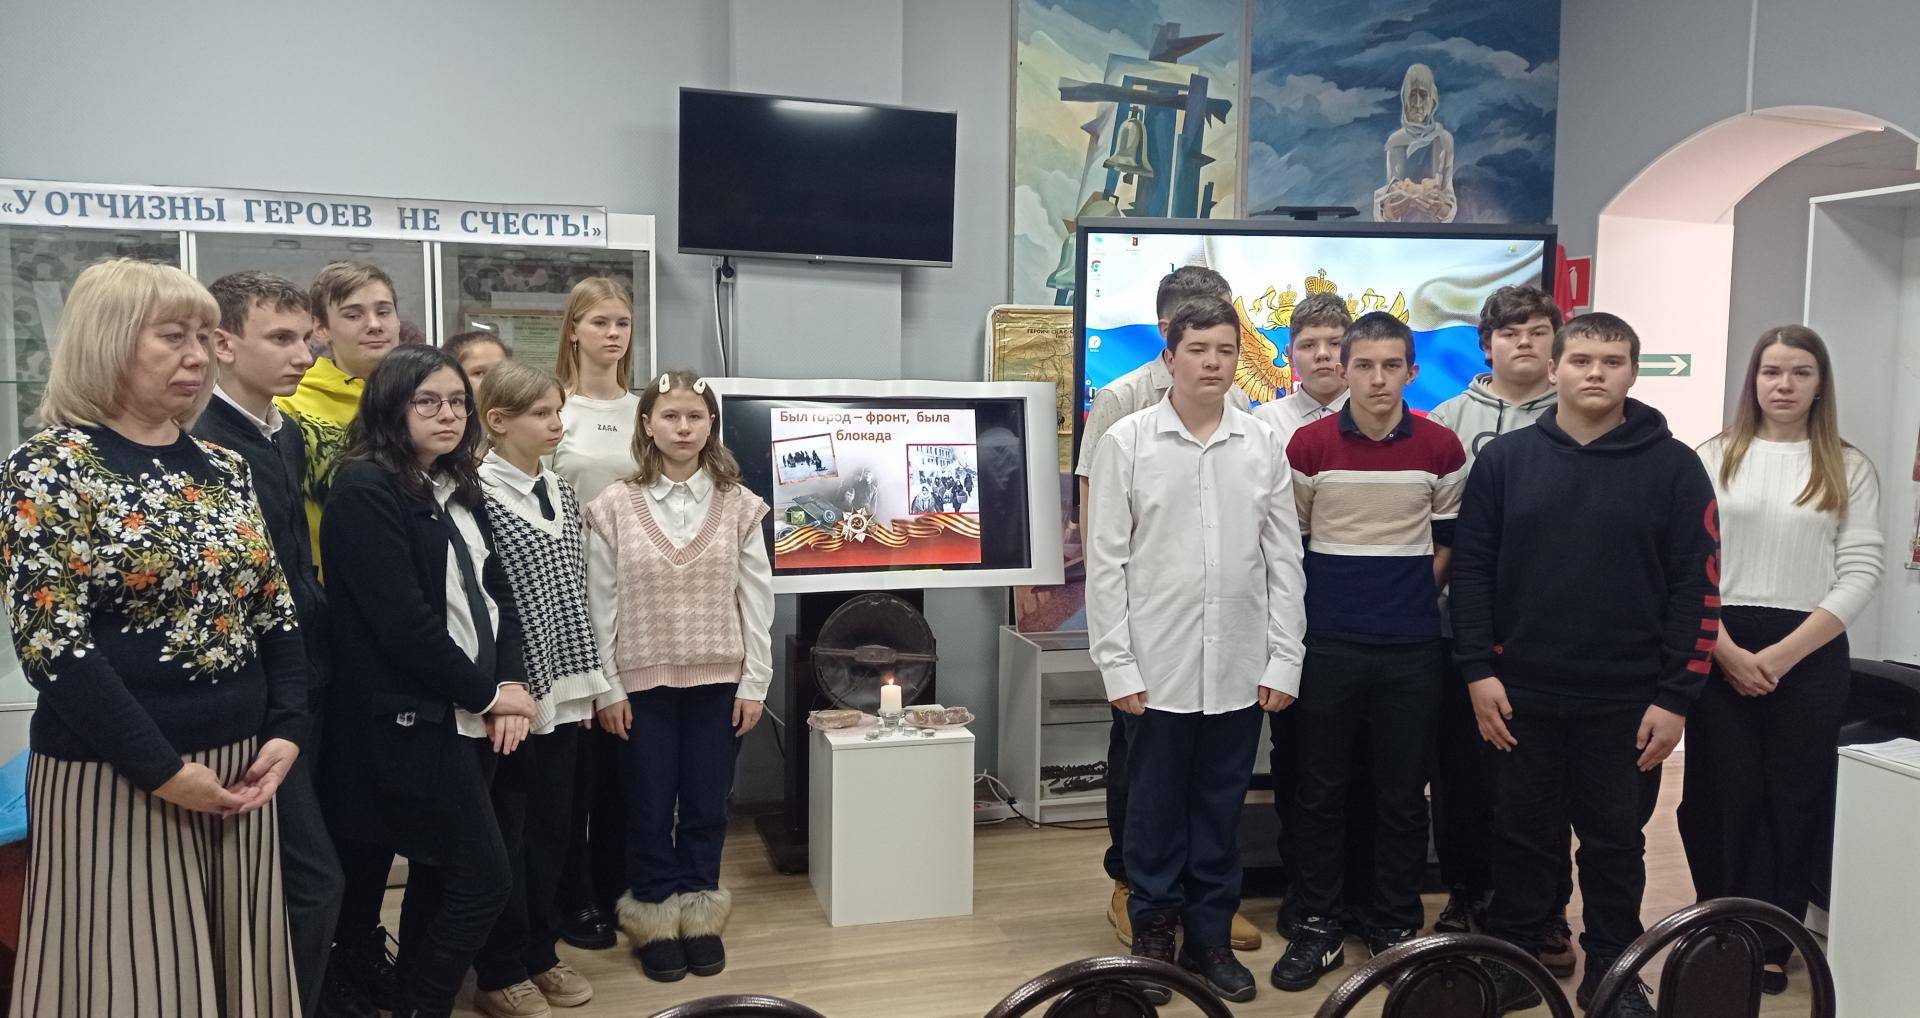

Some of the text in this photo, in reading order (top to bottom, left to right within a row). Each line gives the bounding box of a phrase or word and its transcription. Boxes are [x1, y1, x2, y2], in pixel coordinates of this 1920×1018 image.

[1, 189, 602, 237] «У ОТЧИЗНЫ ГЕРОЕВ НЕ СЧЕСТЬ!»
[780, 411, 808, 422] Был
[812, 413, 851, 424] город
[866, 411, 910, 424] фронт,
[917, 411, 950, 423] была
[836, 429, 892, 443] блокада
